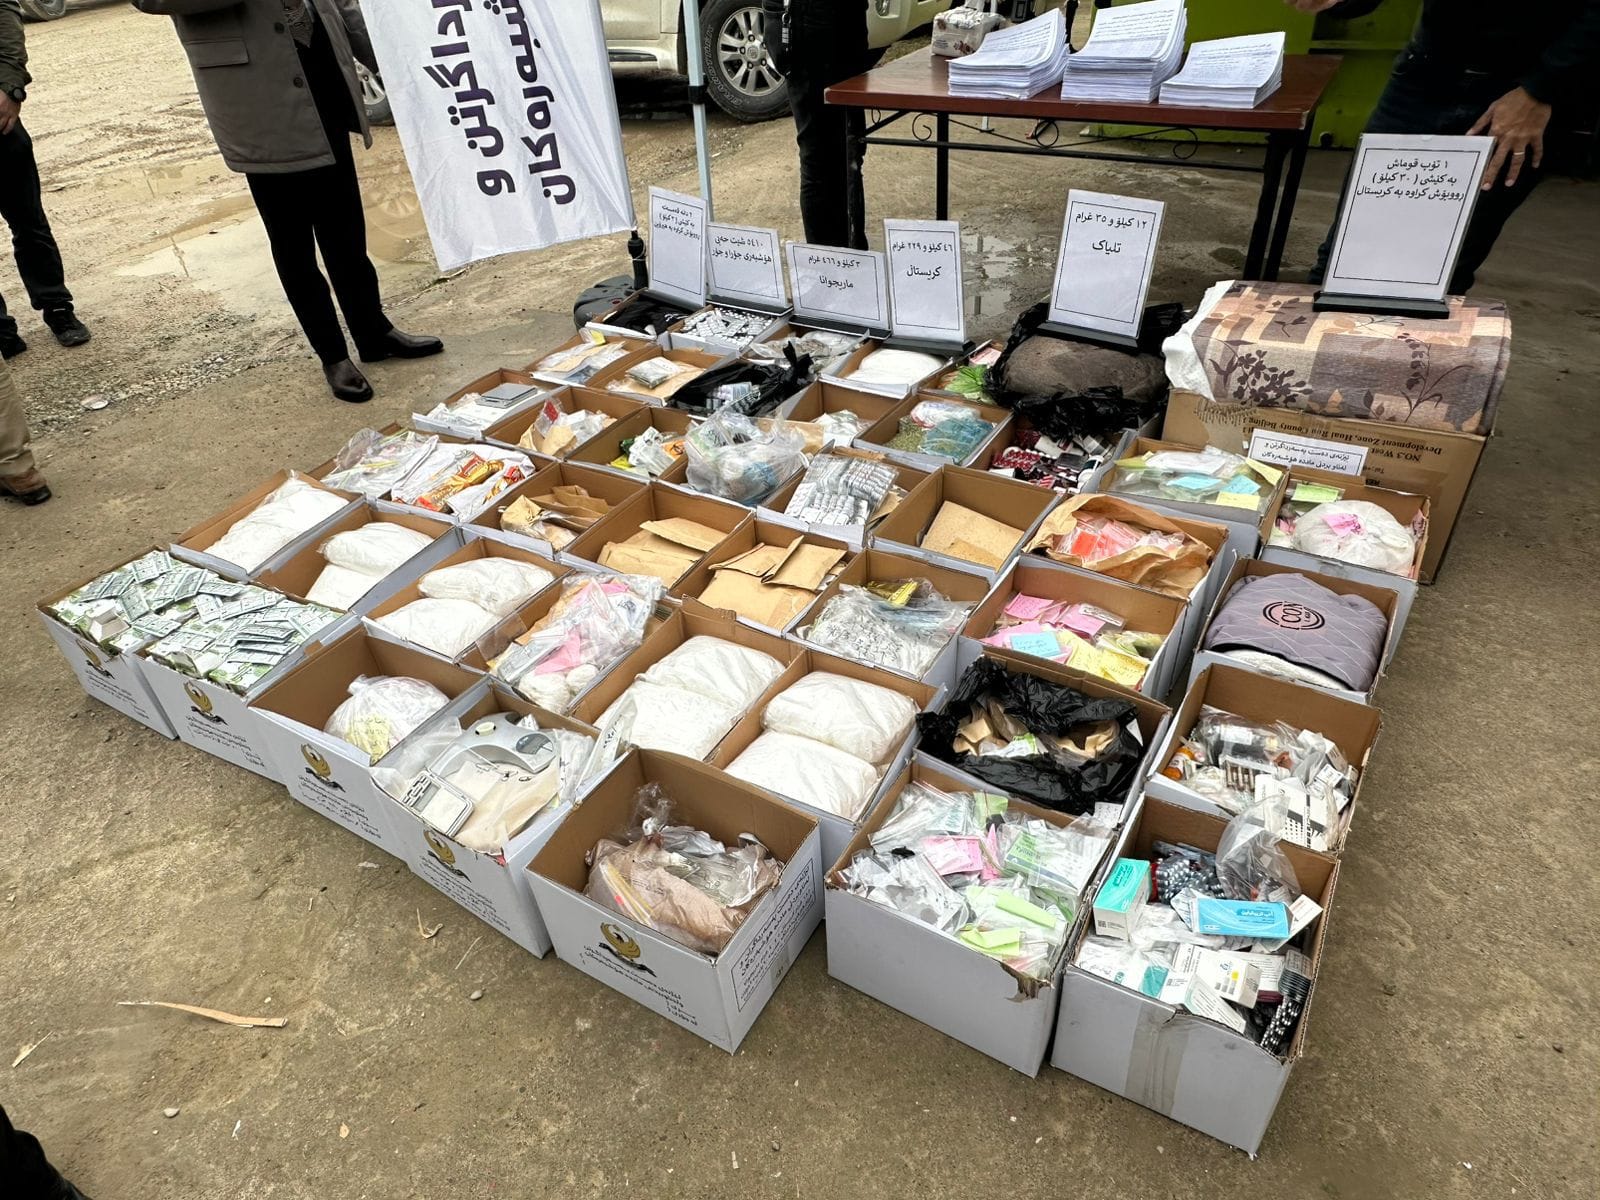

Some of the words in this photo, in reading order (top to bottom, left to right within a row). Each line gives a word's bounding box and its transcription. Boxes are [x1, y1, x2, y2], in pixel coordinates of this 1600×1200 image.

[1387, 158, 1419, 171] قوماش
[476, 169, 516, 196] و
[1075, 211, 1093, 223] غرام
[1108, 217, 1114, 226] و
[892, 241, 906, 252] غرام
[923, 244, 928, 253] و
[836, 260, 841, 268] و
[1248, 417, 1277, 430] Beijing
[1382, 440, 1443, 456] Development
